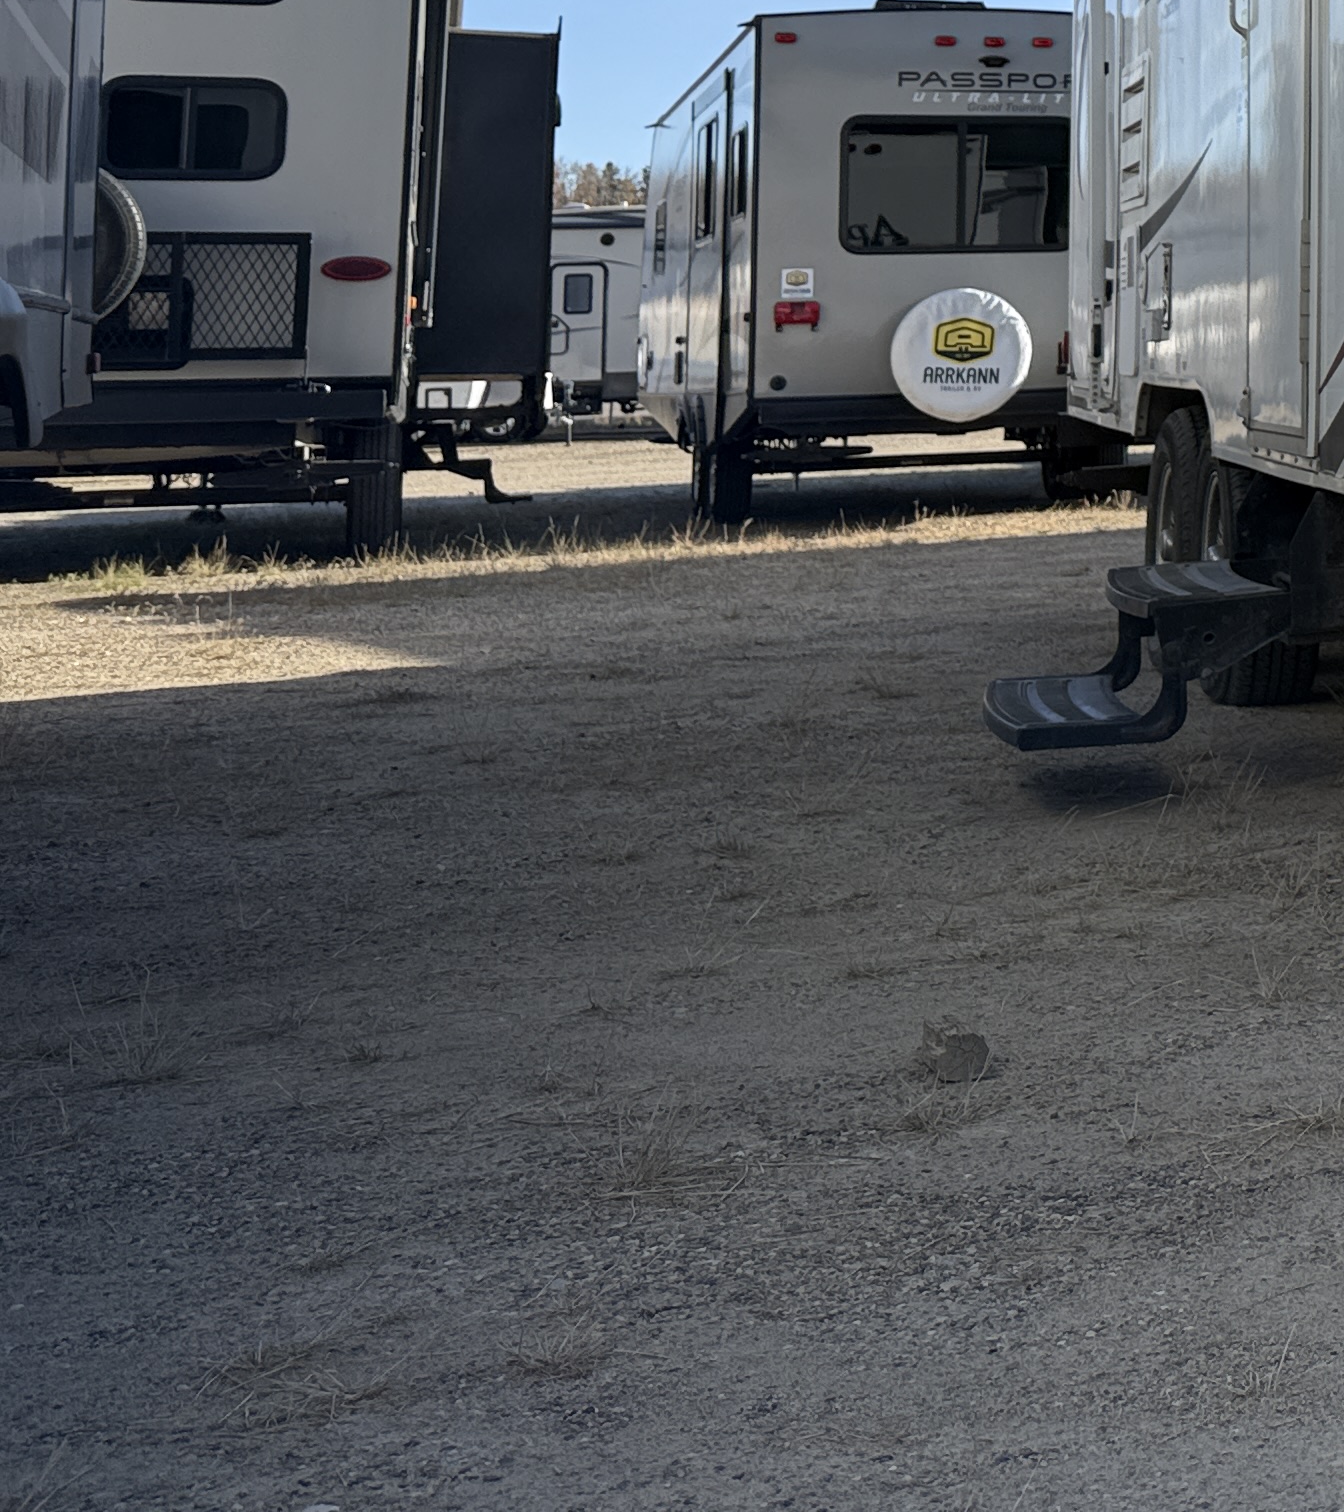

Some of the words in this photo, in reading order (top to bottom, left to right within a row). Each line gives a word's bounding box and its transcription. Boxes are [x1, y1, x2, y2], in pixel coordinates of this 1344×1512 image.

[967, 103, 1003, 113] Grand
[1005, 104, 1048, 114] Touring
[923, 366, 1001, 385] ARRKANN
